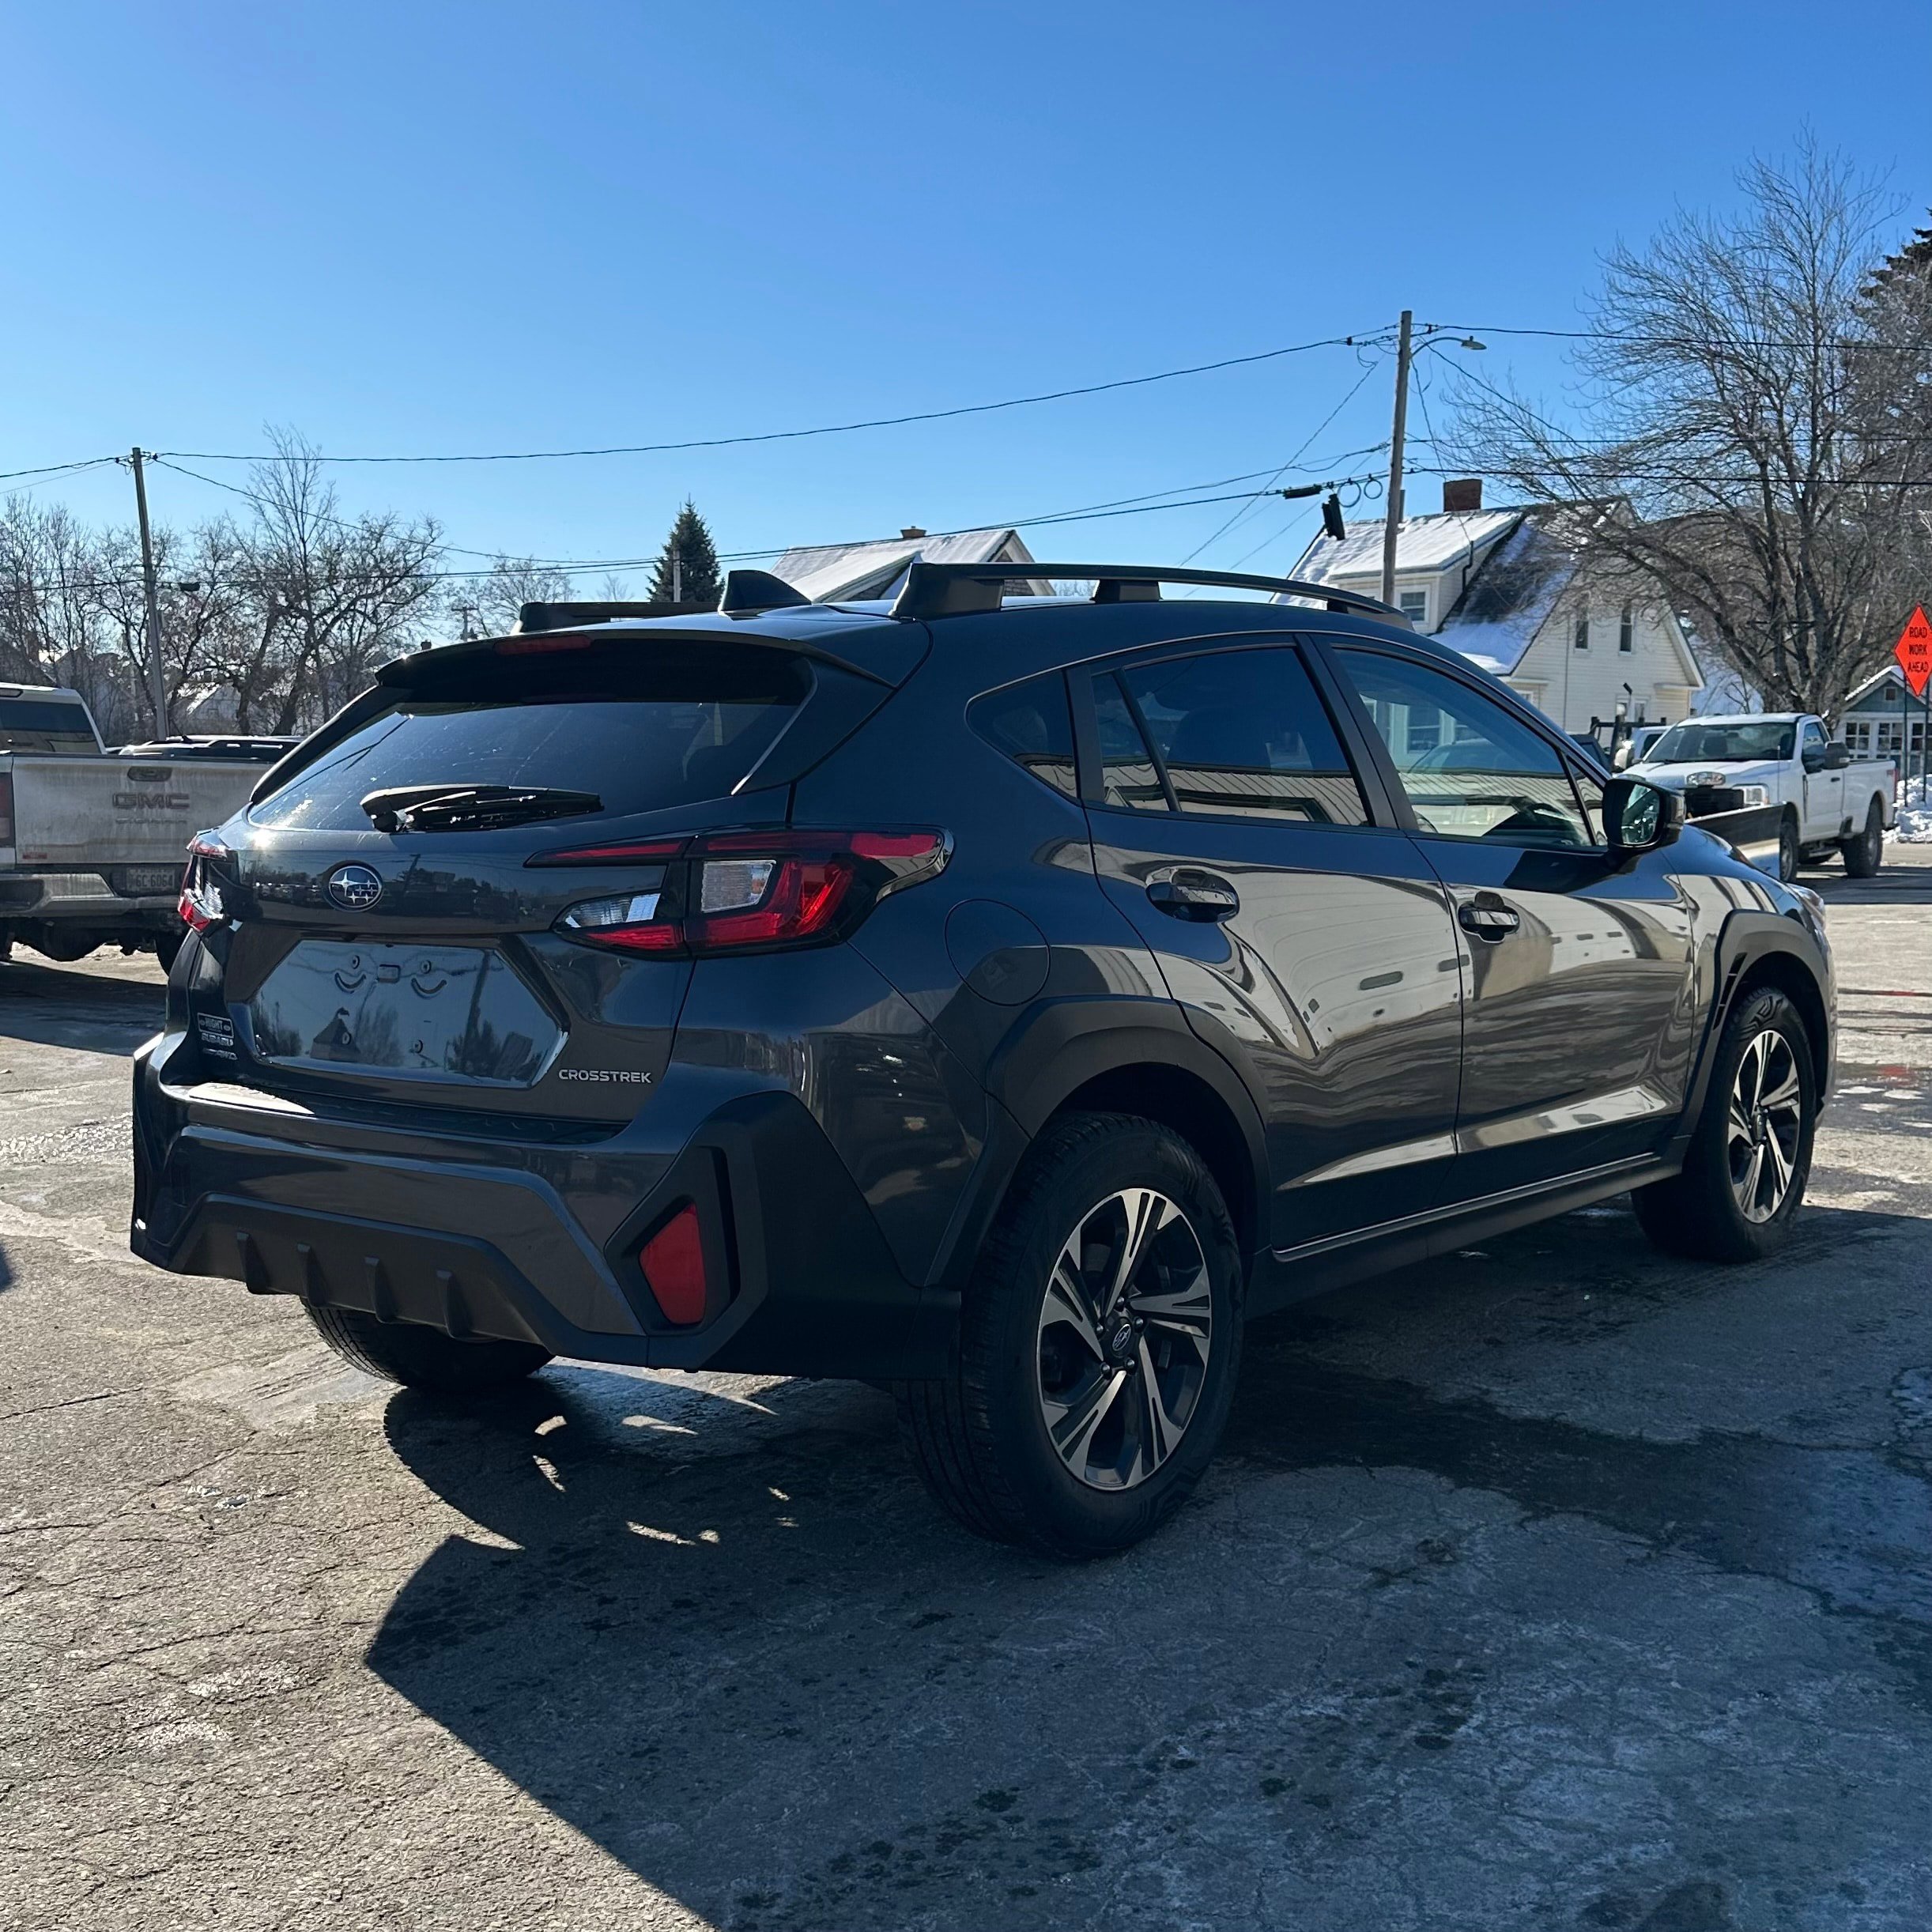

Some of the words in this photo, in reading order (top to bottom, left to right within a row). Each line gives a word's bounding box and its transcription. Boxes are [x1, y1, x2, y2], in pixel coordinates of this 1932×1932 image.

[1909, 627, 1927, 638] ROAD
[1909, 644, 1927, 655] WORK
[1907, 662, 1929, 673] AHEAD
[112, 793, 190, 809] GMC
[202, 1032, 234, 1047] SUBARU
[558, 1069, 651, 1084] CROSSTREK
